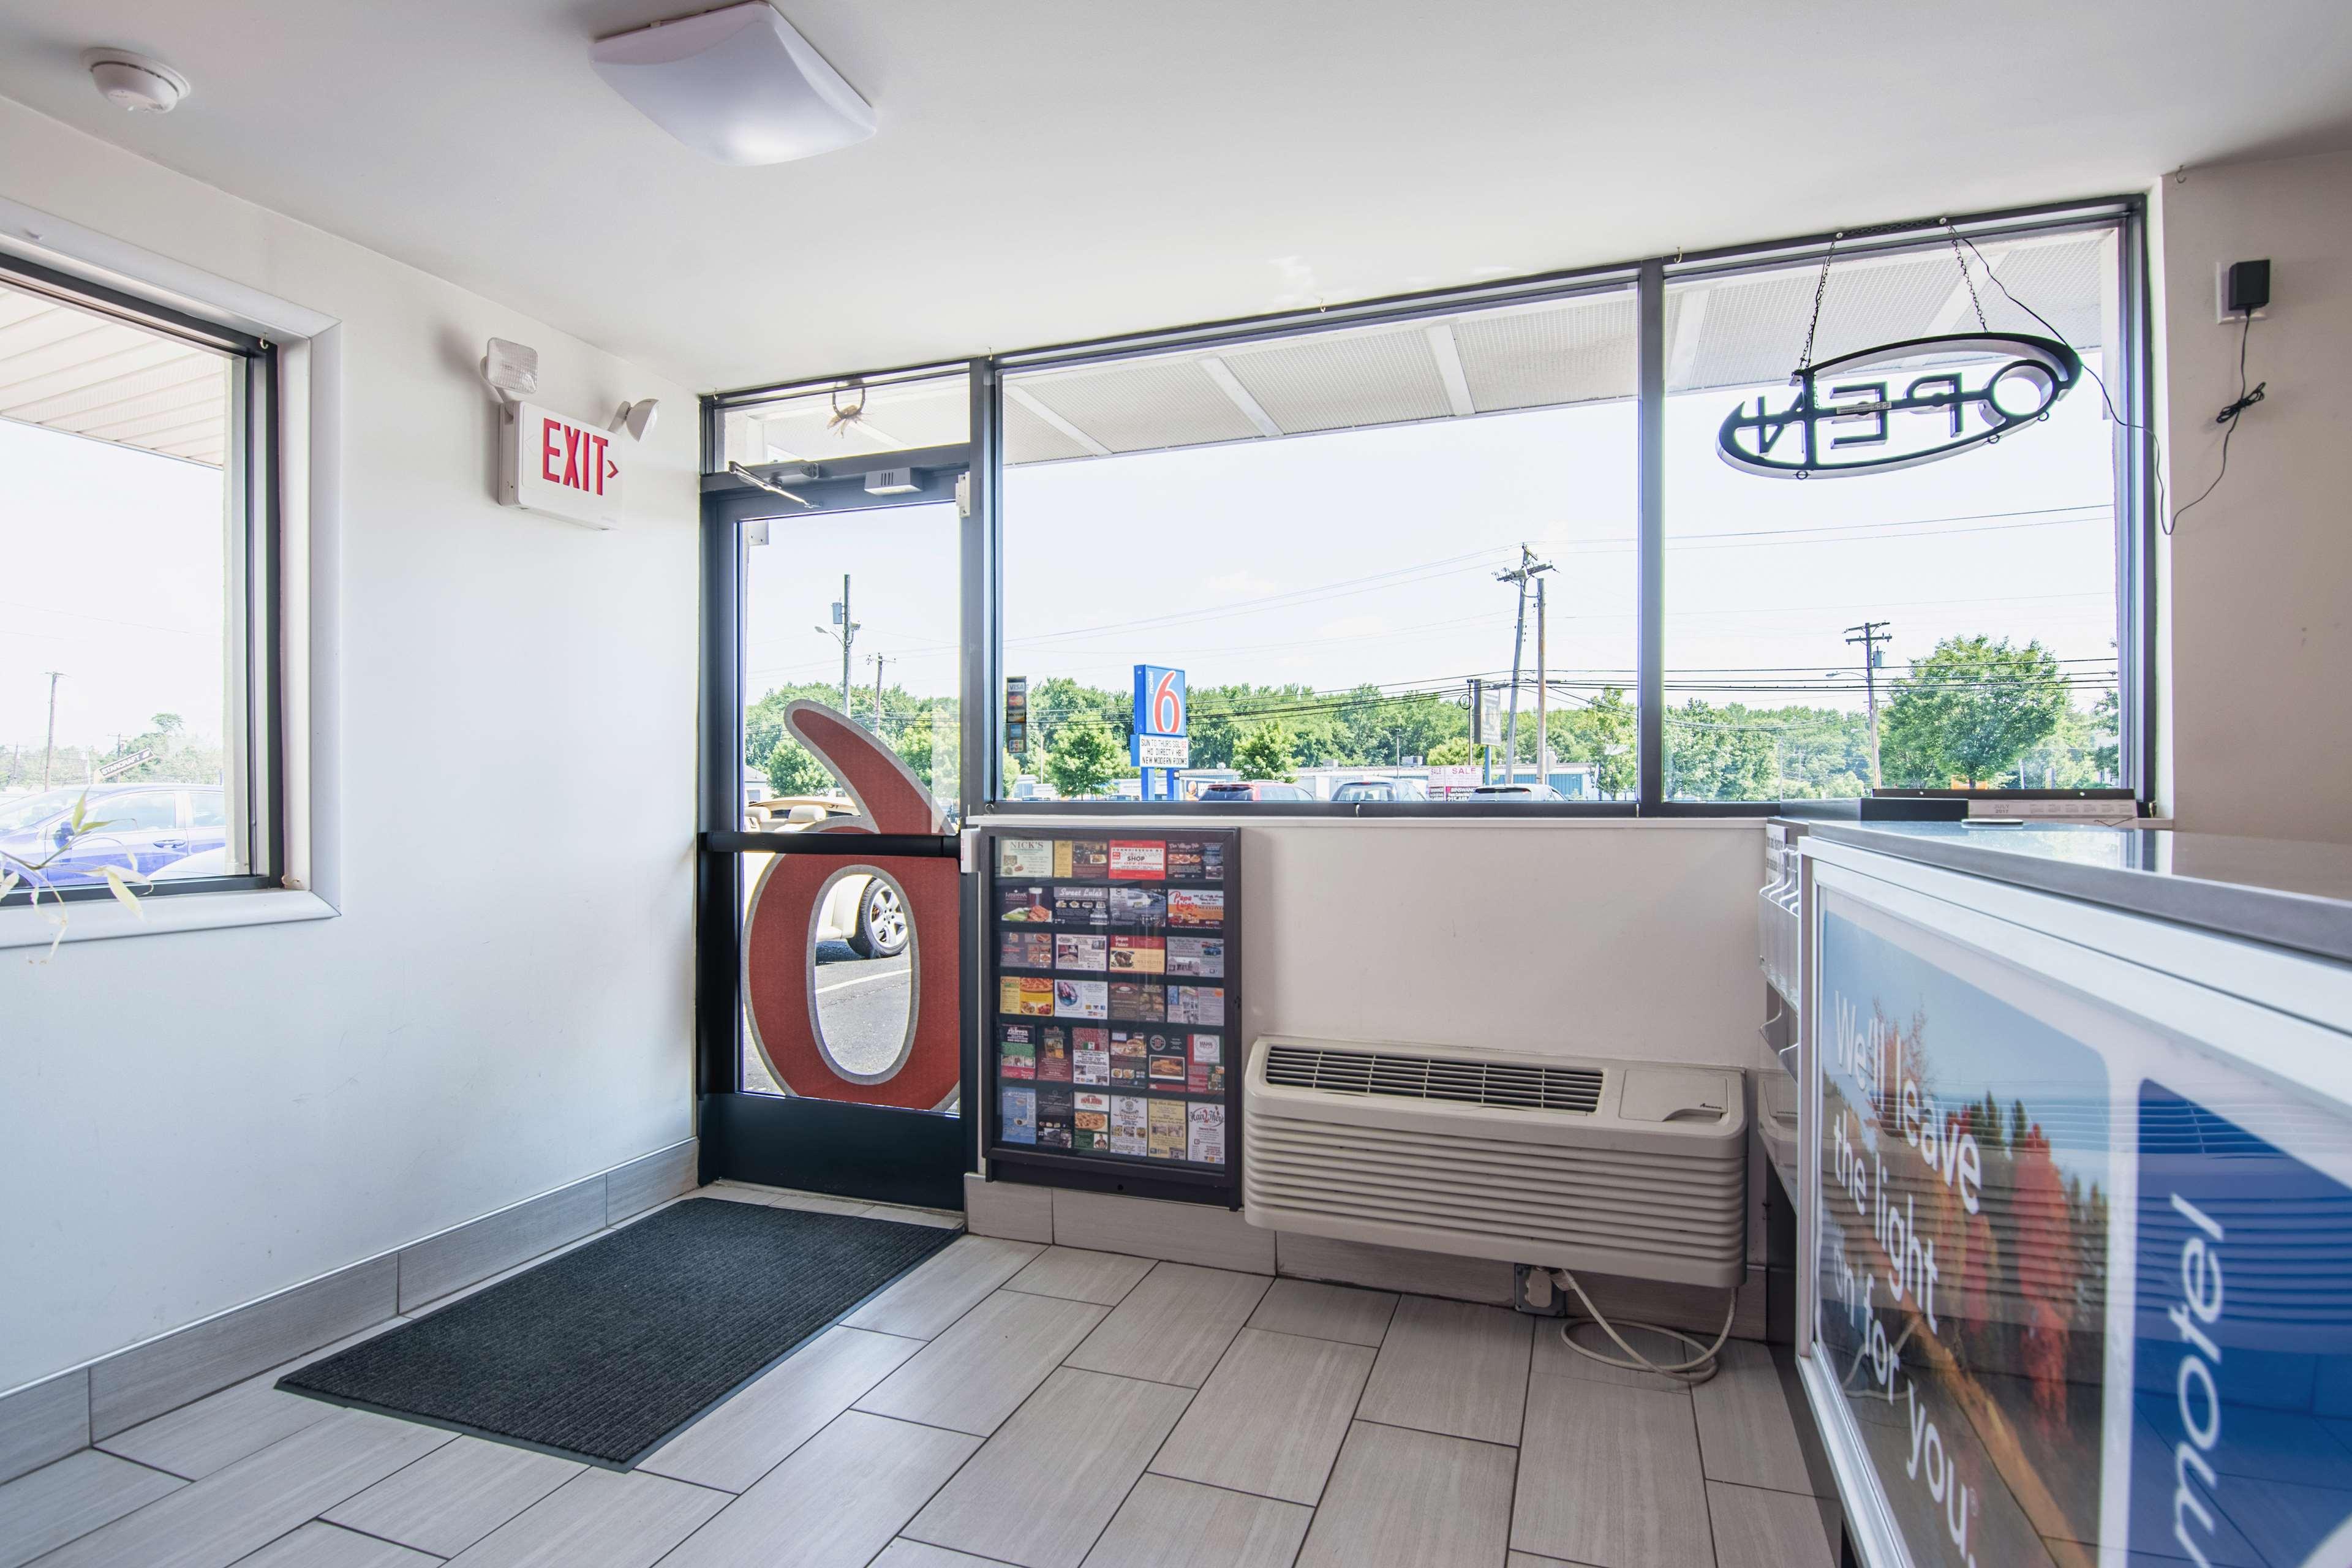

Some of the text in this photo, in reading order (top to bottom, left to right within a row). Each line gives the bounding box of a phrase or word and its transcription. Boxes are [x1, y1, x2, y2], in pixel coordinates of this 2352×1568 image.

[542, 417, 609, 496] EXIT
[1153, 670, 1182, 734] 6
[101, 755, 140, 775] STARCRAFT
[1060, 888, 1082, 897] Sweet
[1169, 891, 1191, 904] Papa
[1834, 989, 1982, 1215] We'll leave
[1834, 1109, 1938, 1335] the light
[1833, 1243, 1855, 1328] on
[1864, 1273, 1899, 1406] for
[2168, 1191, 2224, 1568] motel
